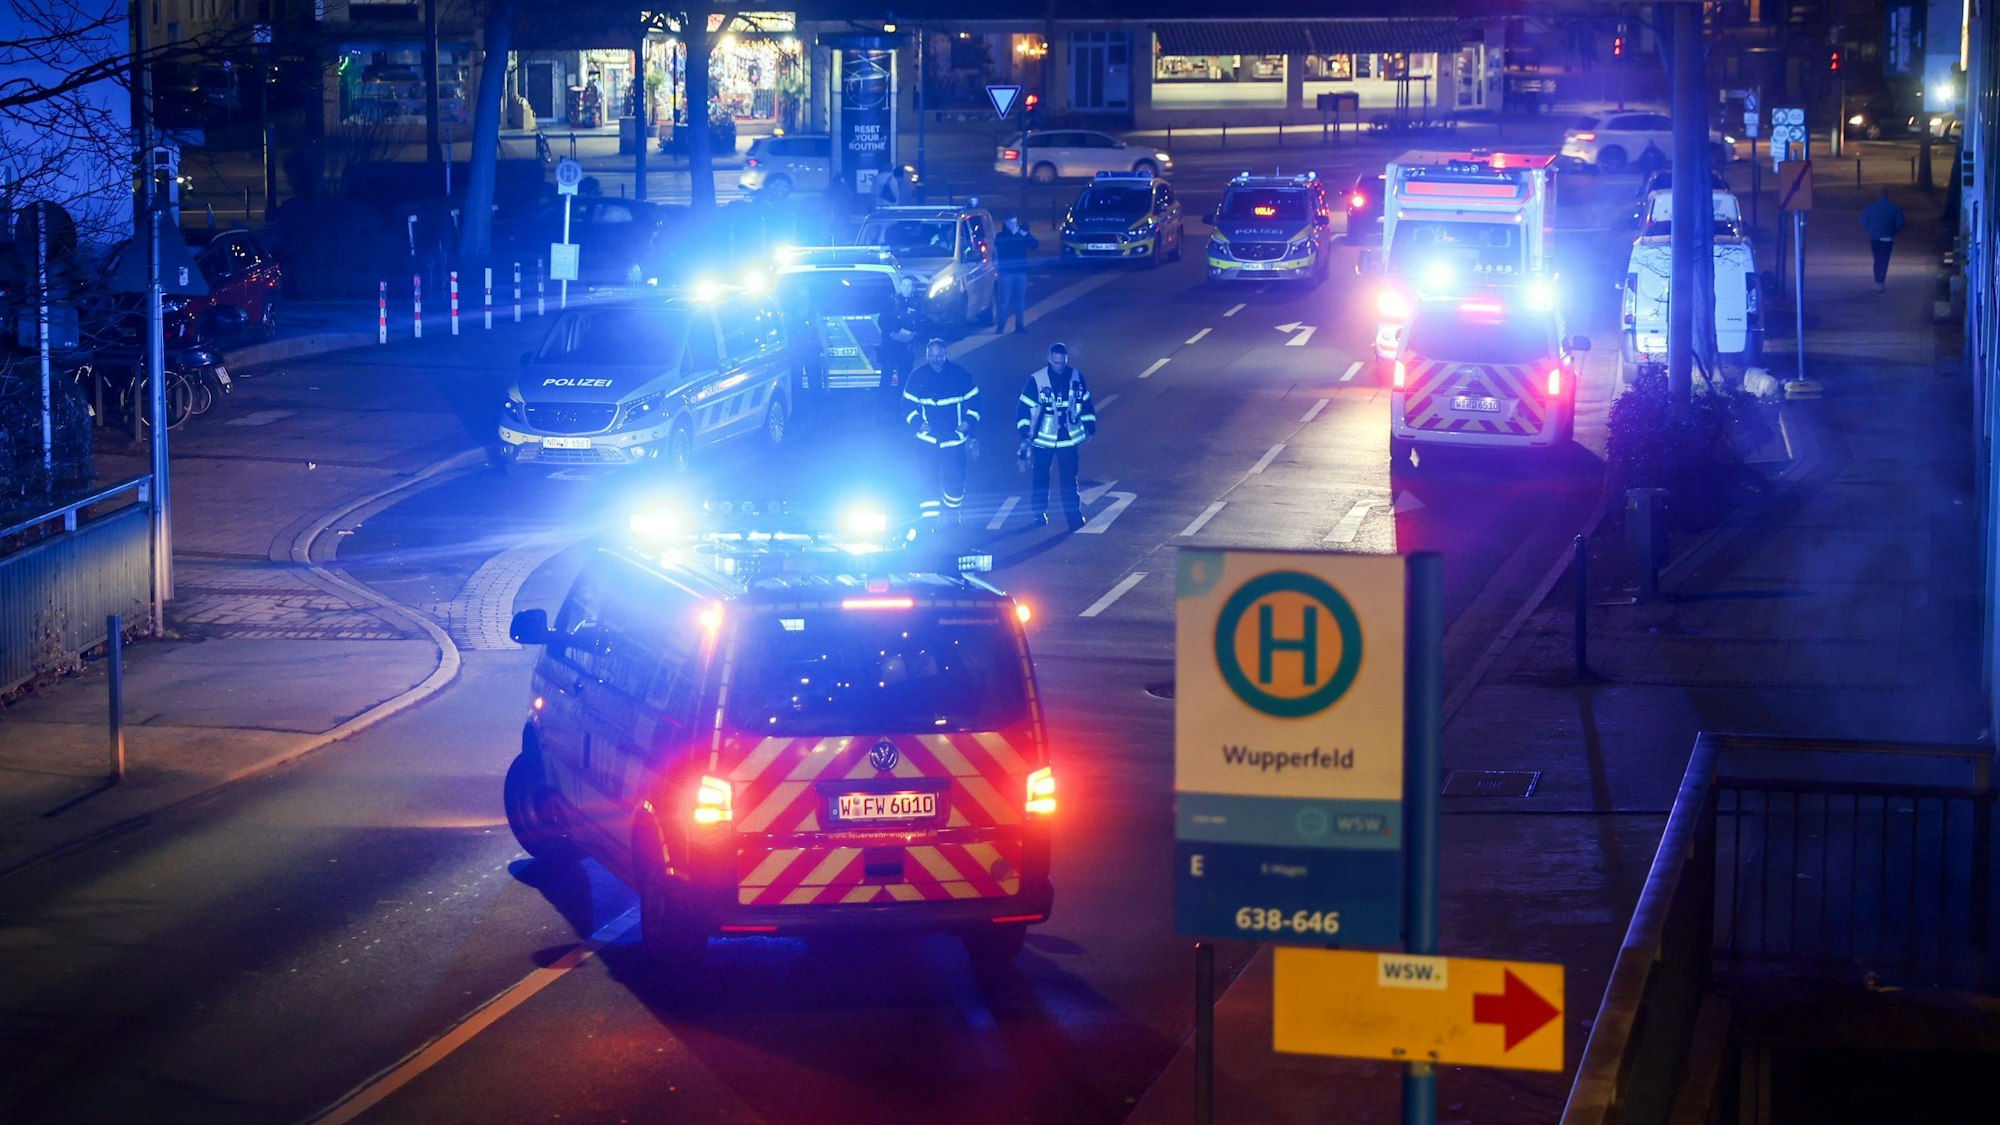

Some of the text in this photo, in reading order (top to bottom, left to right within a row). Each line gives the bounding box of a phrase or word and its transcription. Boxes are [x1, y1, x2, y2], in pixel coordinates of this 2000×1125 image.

[854, 125, 881, 133] RESET
[855, 133, 879, 142] YOUR
[849, 141, 885, 150] ROUTINE
[542, 379, 614, 388] POLIZEI
[1259, 604, 1317, 686] H
[1223, 744, 1355, 773] Wupperfeld
[840, 796, 933, 816] W FW 6010
[1190, 855, 1204, 877] E
[1235, 907, 1340, 934] 638-646
